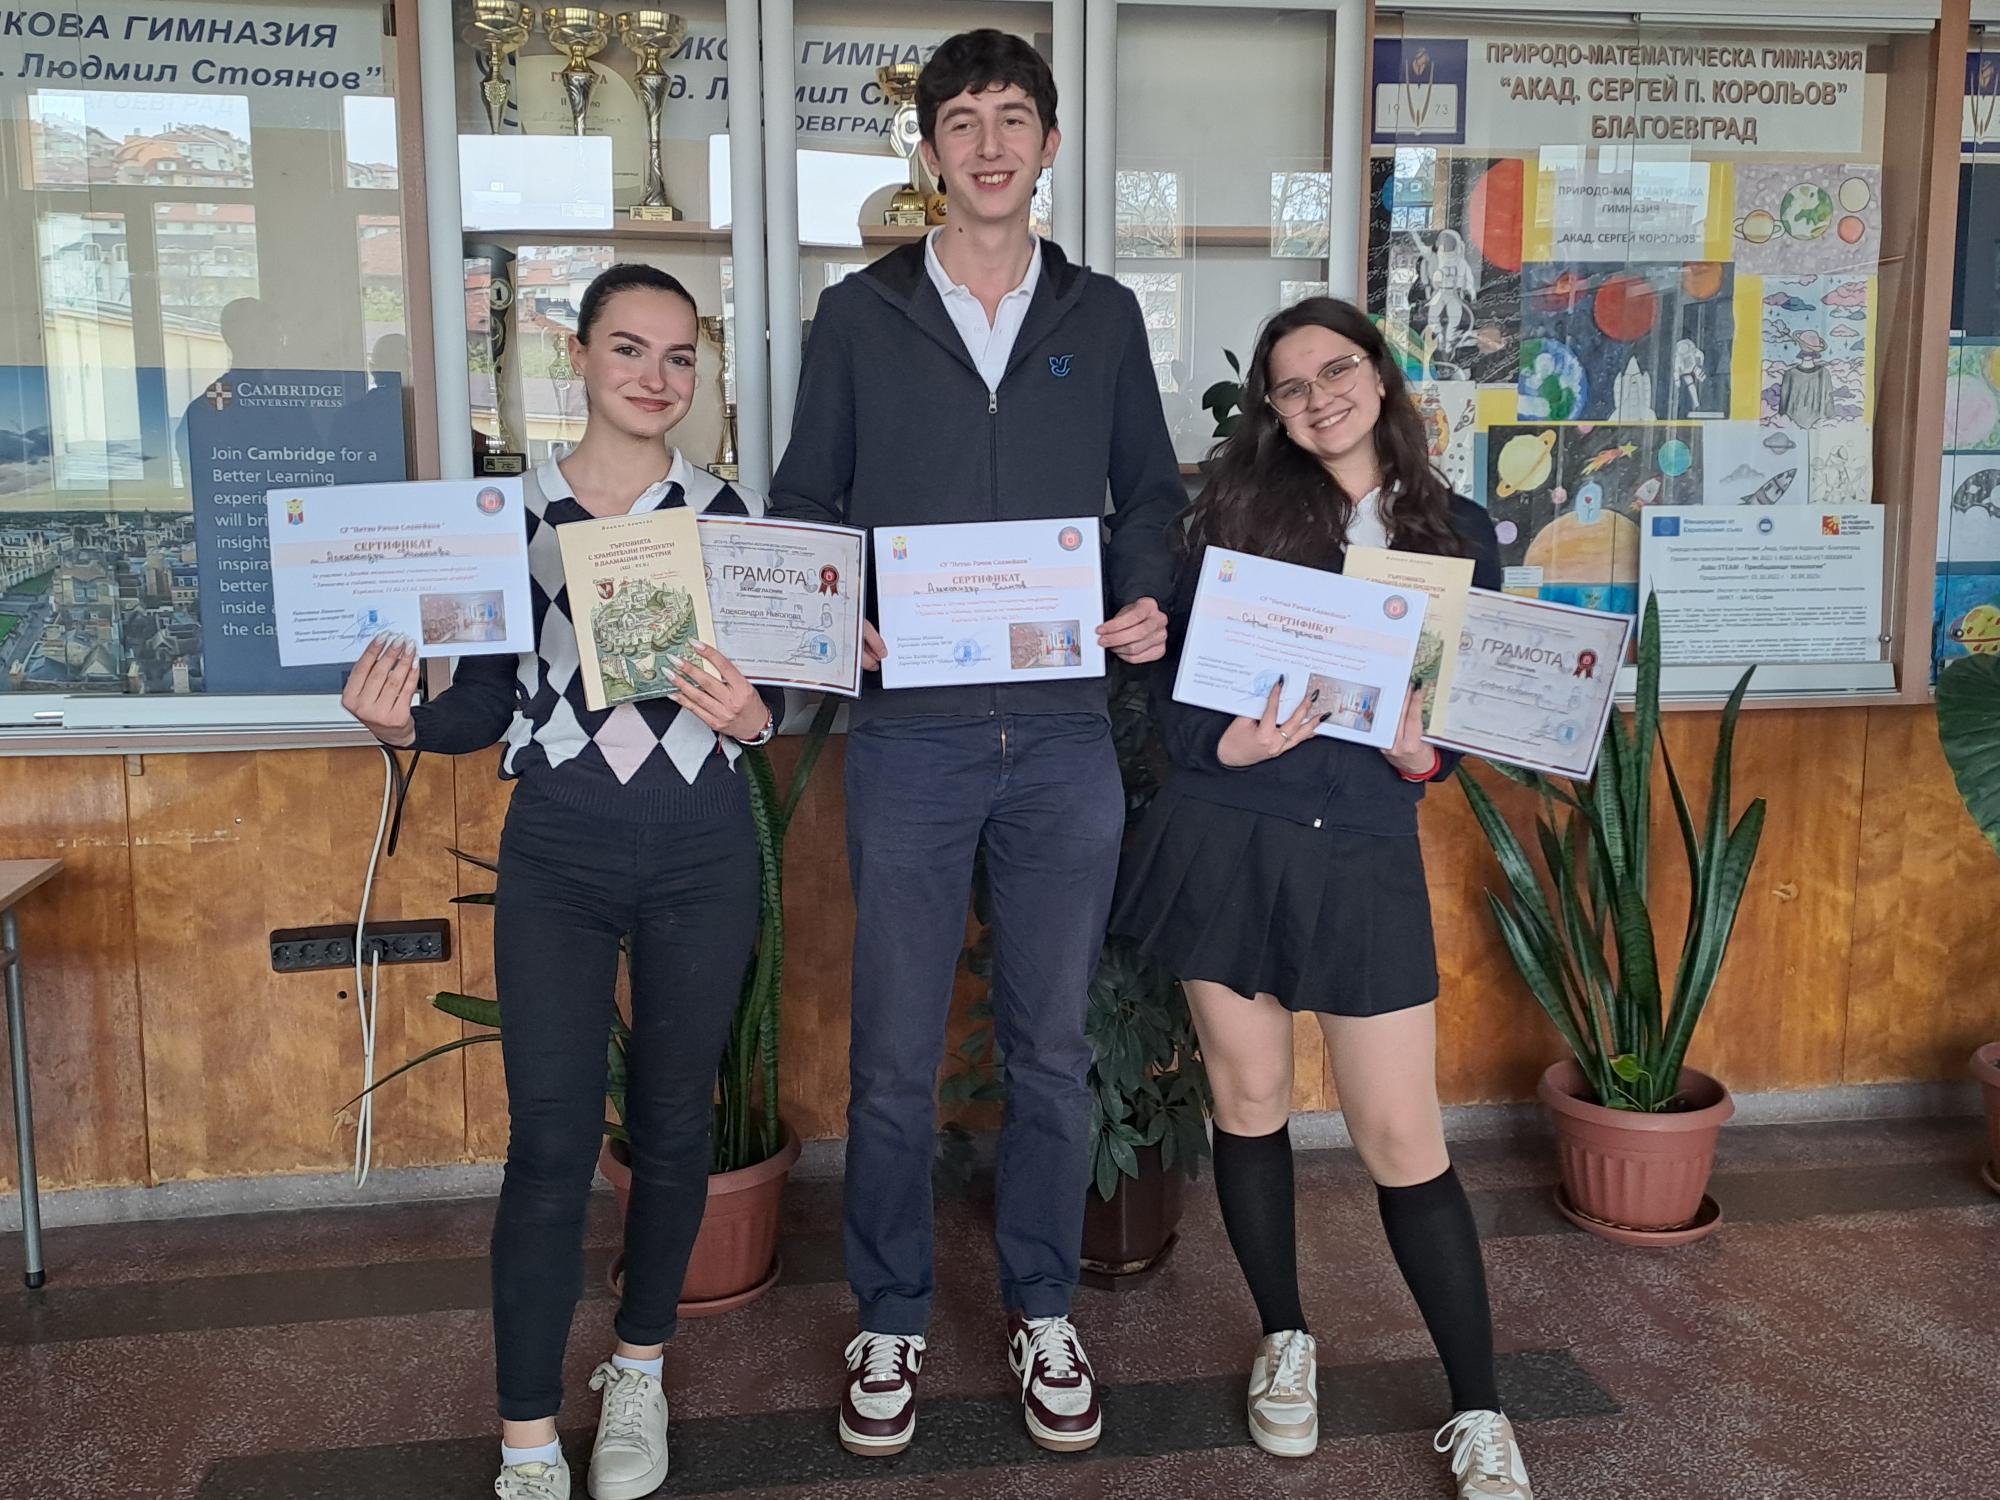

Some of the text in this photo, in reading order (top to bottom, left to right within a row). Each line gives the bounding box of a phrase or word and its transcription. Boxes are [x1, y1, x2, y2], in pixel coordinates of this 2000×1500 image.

[0, 11, 338, 48] КОВА ГИМНАЗИЯ
[802, 41, 922, 66] ГИМНА
[1485, 42, 1864, 72] ПРИРОДО-МАТЕМАТИЧЕСКА ГИМНАЗИЯ
[18, 53, 178, 83] Людмил
[1588, 74, 1678, 104] СЕРГЕЙ
[1684, 81, 1707, 104] П.
[1592, 115, 1758, 144] БЛАГОЕВГРАД
[1602, 204, 1660, 214] ГИМНАЗИЯ
[1598, 232, 1636, 243] СЕРГЕЙ
[237, 382, 343, 399] CAMBRIDGE
[239, 398, 343, 408] UNIVERSITY PRESS
[211, 446, 377, 463] Join Cambridge for a
[213, 468, 335, 486] Better Learning
[214, 491, 267, 508] experie
[215, 512, 268, 527] will bri
[354, 539, 432, 552] СЕРТИФИКАТ
[219, 557, 272, 573] inspira
[723, 565, 808, 586] ГРАМОТА
[952, 573, 1021, 584] СЕРТИФИКАТ
[220, 579, 268, 593] better
[222, 601, 266, 615] inside
[222, 622, 248, 636] the
[1267, 612, 1335, 635] СЕРТИФИКАТ
[1480, 637, 1564, 668] ГРАМОТА
